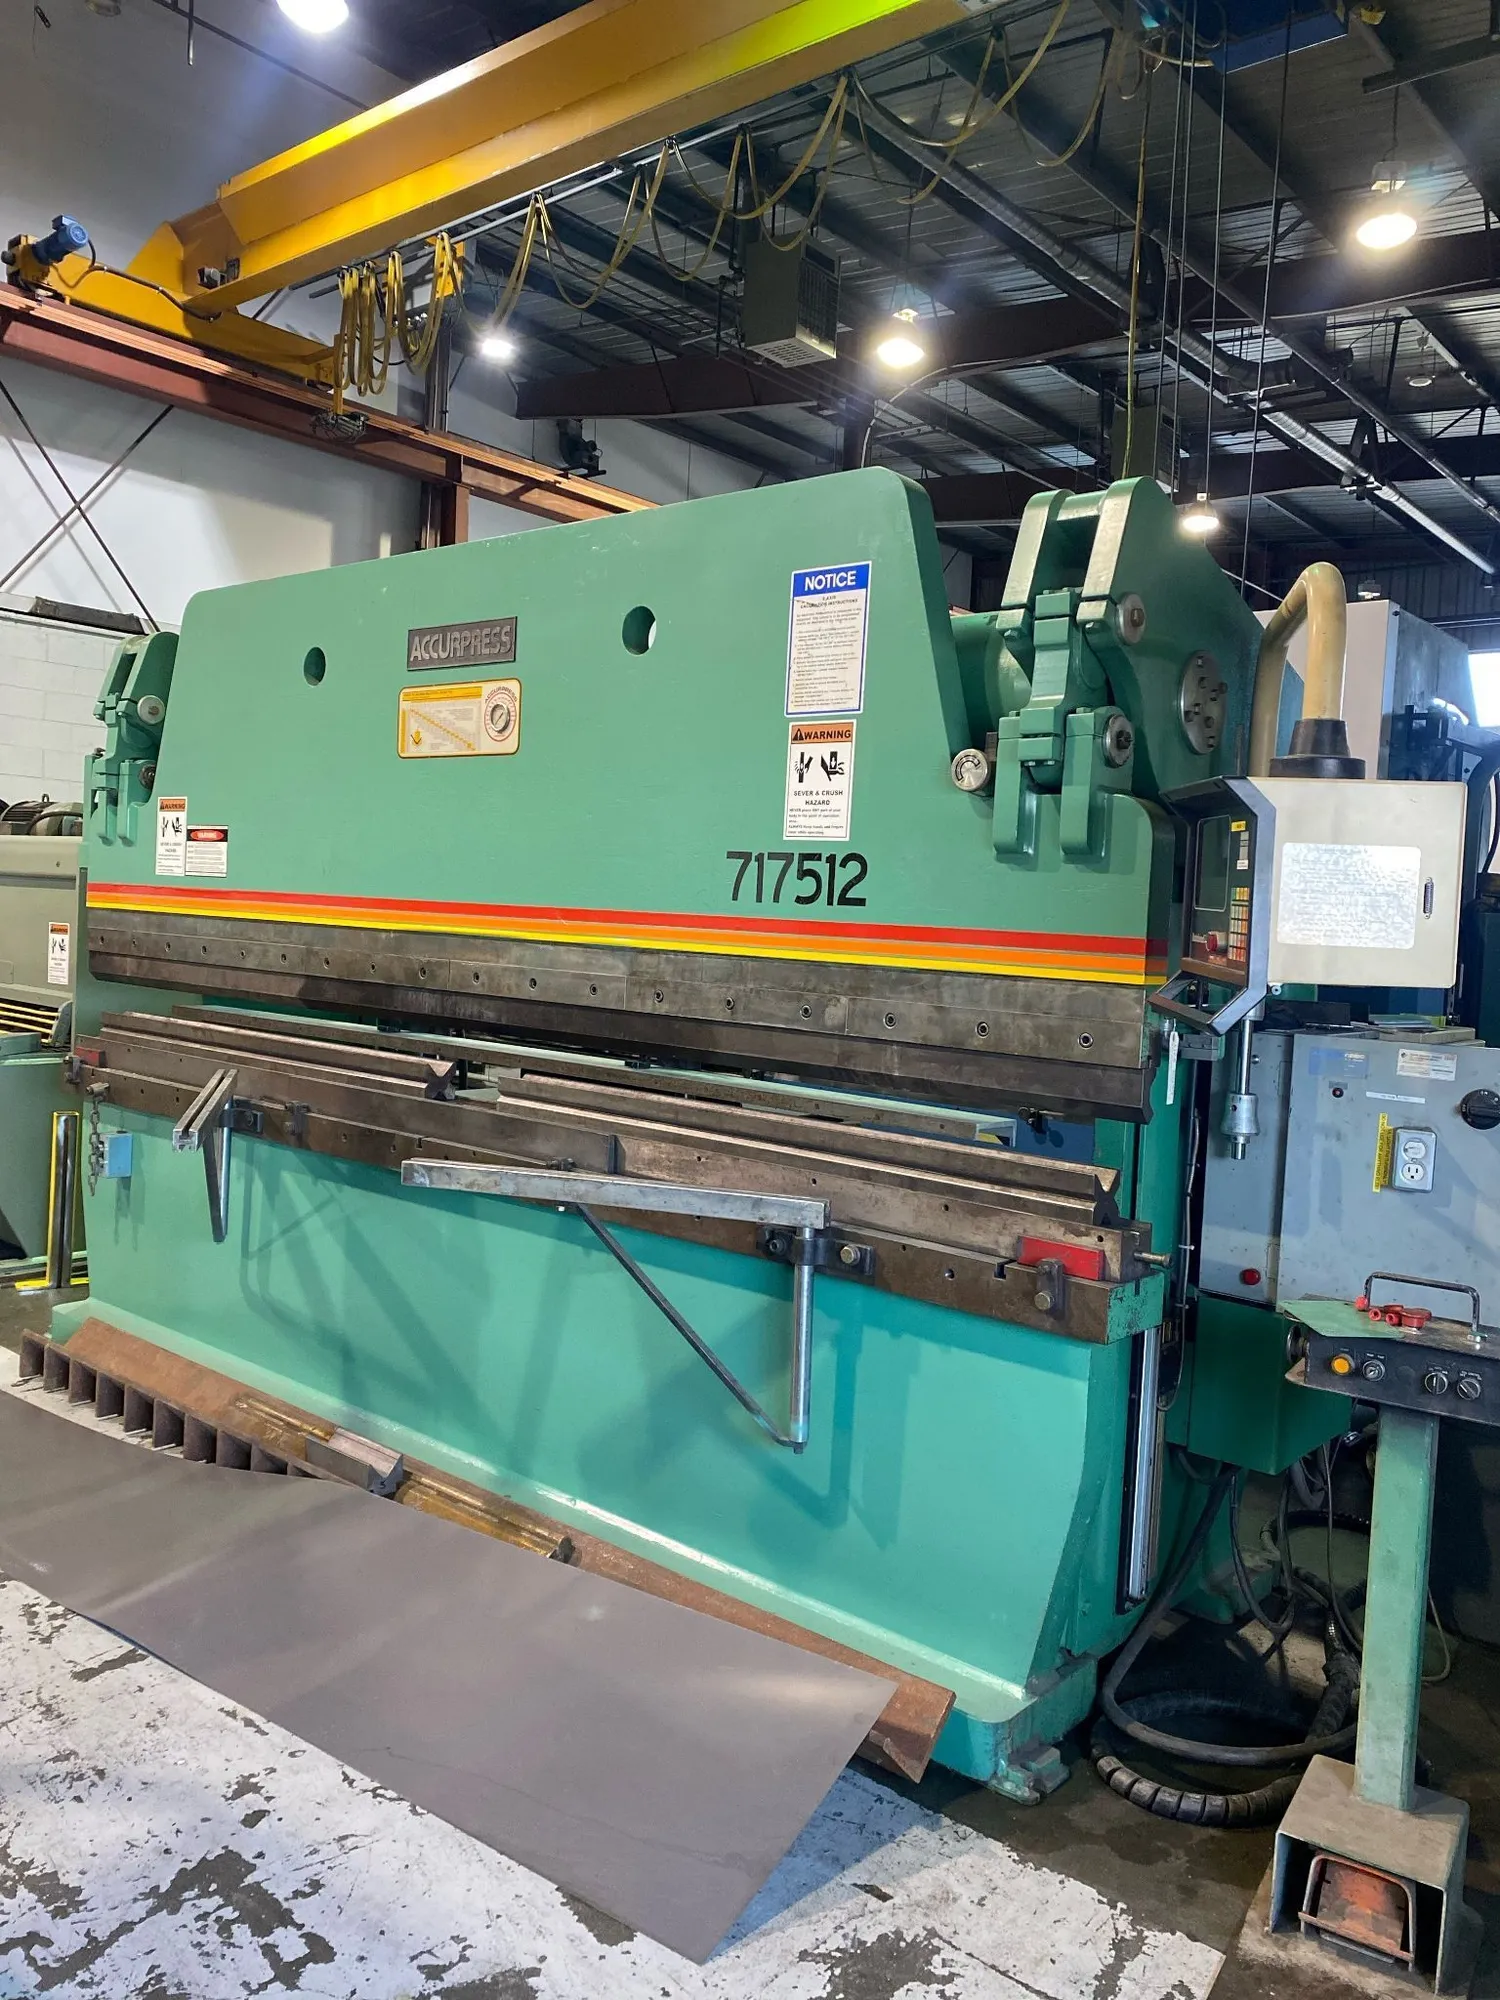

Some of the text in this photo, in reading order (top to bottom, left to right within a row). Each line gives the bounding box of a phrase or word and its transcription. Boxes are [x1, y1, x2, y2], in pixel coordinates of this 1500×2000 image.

[804, 570, 857, 591] NOTICE
[410, 625, 512, 661] ACCURPRESS
[803, 729, 851, 740] WARNING
[726, 850, 868, 907] 717512
